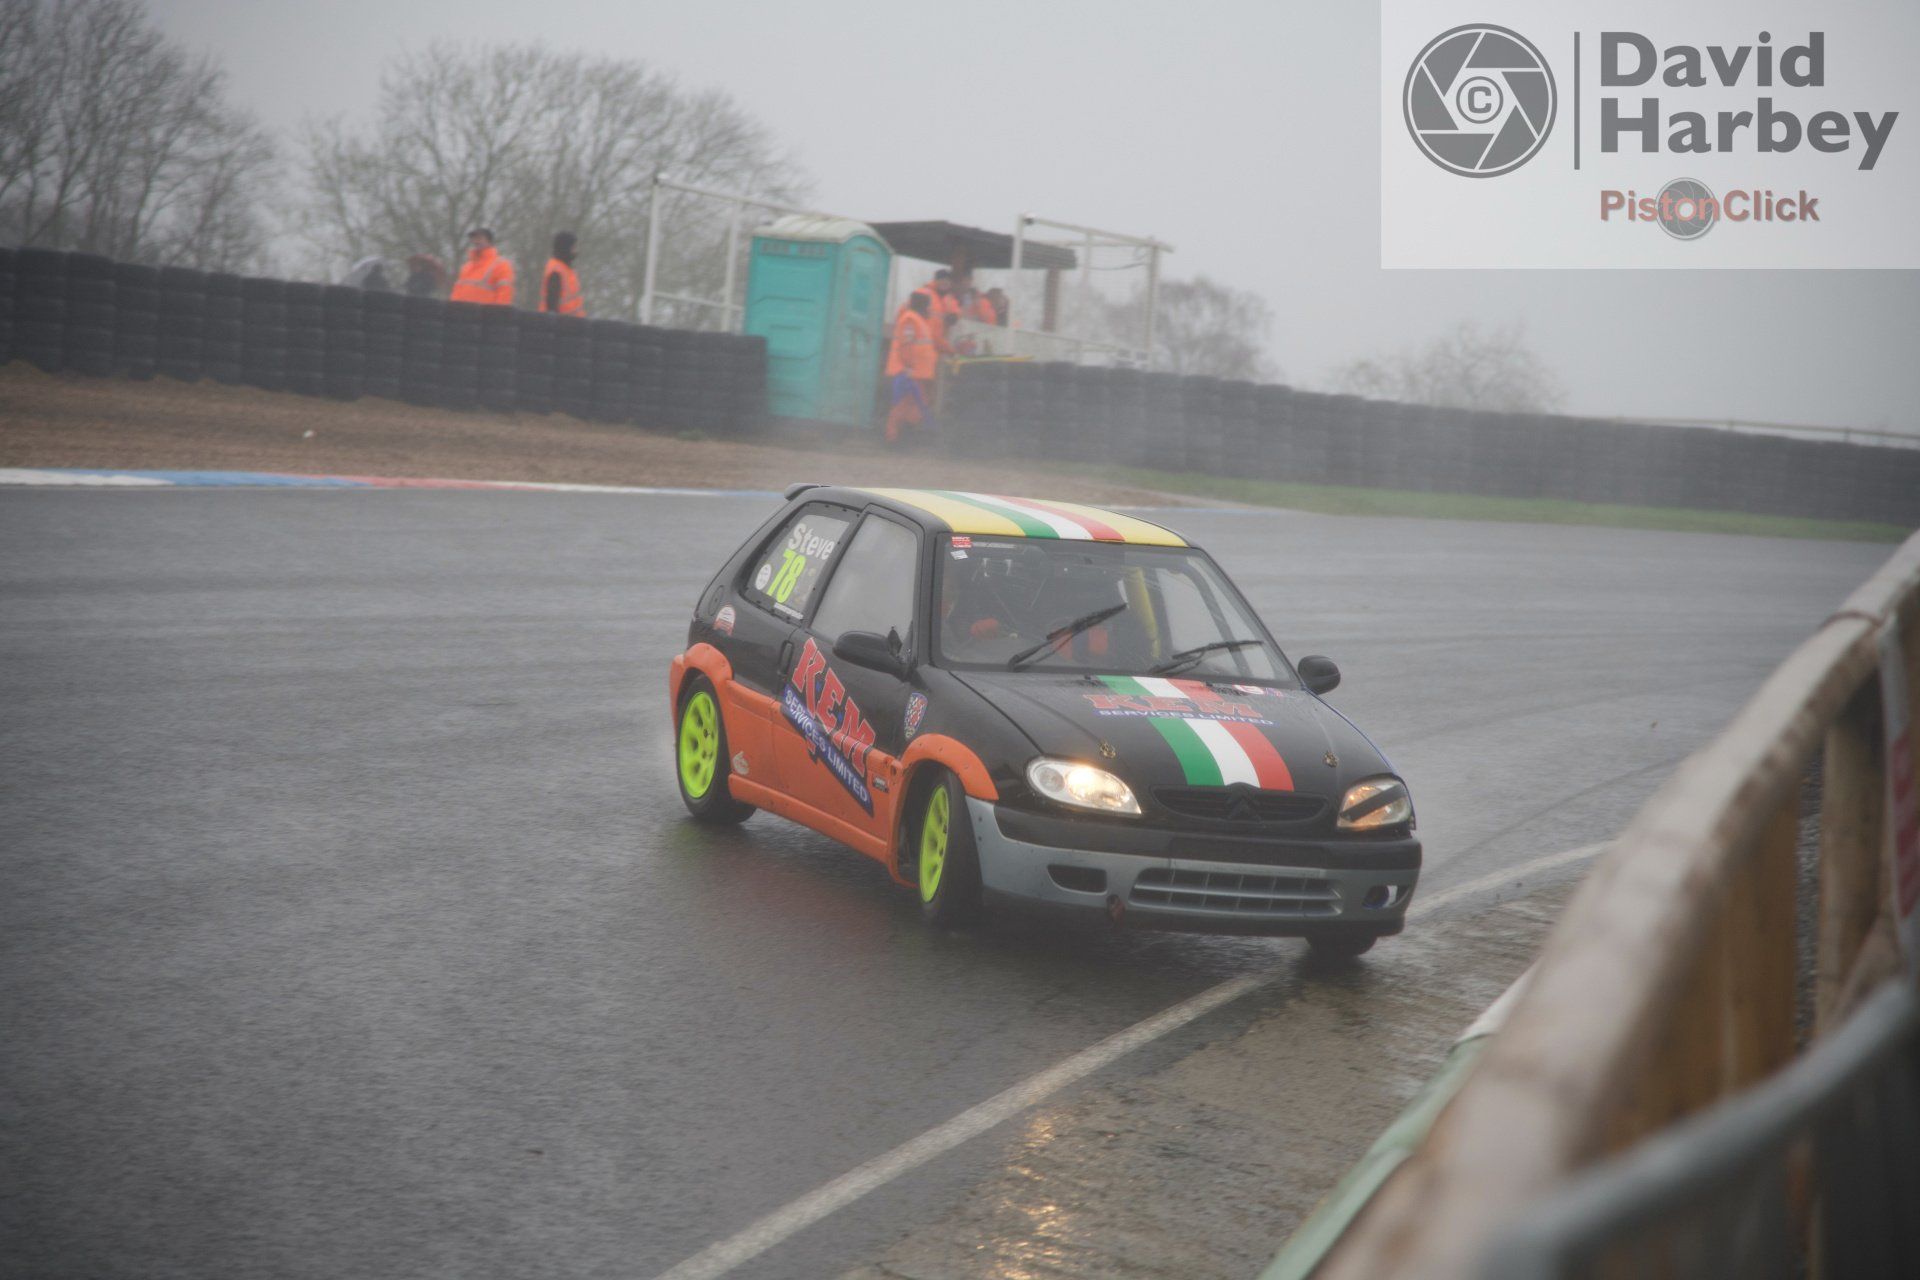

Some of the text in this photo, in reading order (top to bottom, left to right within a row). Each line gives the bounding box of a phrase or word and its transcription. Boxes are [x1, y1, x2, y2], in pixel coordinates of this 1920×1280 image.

[788, 523, 835, 560] Steve
[766, 548, 806, 603] 78
[1100, 709, 1275, 726] SERVICES LIMITED
[785, 689, 868, 802] SERVICES LIMITED
